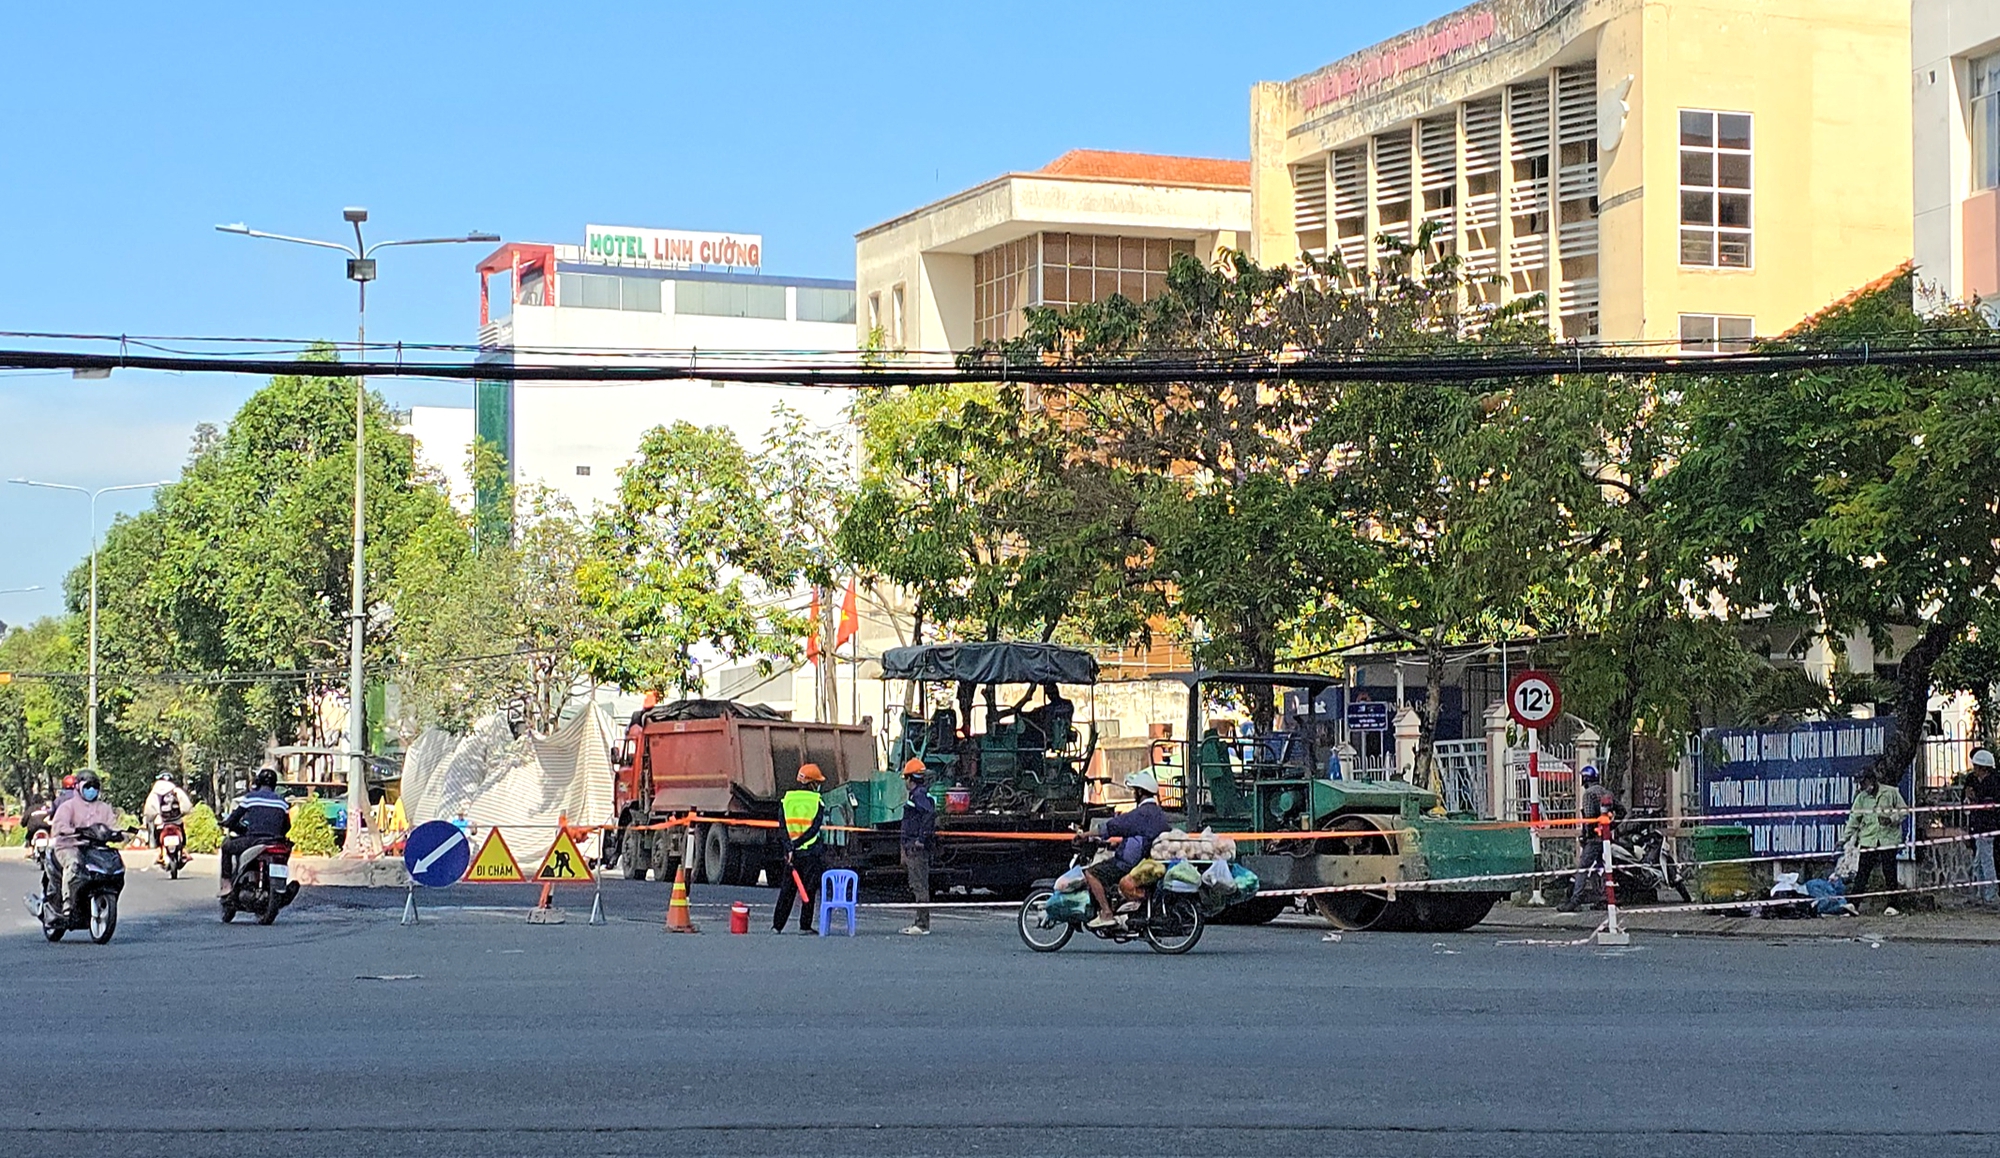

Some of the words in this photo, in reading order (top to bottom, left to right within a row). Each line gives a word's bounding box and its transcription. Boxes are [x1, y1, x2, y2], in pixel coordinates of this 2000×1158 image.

[590, 233, 647, 259] HOTEL
[654, 237, 693, 262] LINH
[700, 236, 759, 267] CƯỜNG
[1762, 730, 1789, 761] CHÍNH
[1791, 722, 1819, 762] QUYỀN
[1821, 726, 1834, 758] VÀ
[1836, 725, 1862, 756] NHÂN
[1864, 722, 1885, 755] DÂN
[1743, 775, 1766, 807] XUÂN
[1767, 775, 1797, 806] KHÁNH
[1799, 769, 1827, 808] QUYẾT
[1829, 773, 1849, 804] TÂM
[1773, 816, 1803, 852] CHUẨN
[1805, 820, 1818, 852] ĐÔ
[476, 865, 486, 876] ĐI
[488, 863, 513, 878] CHẬM
